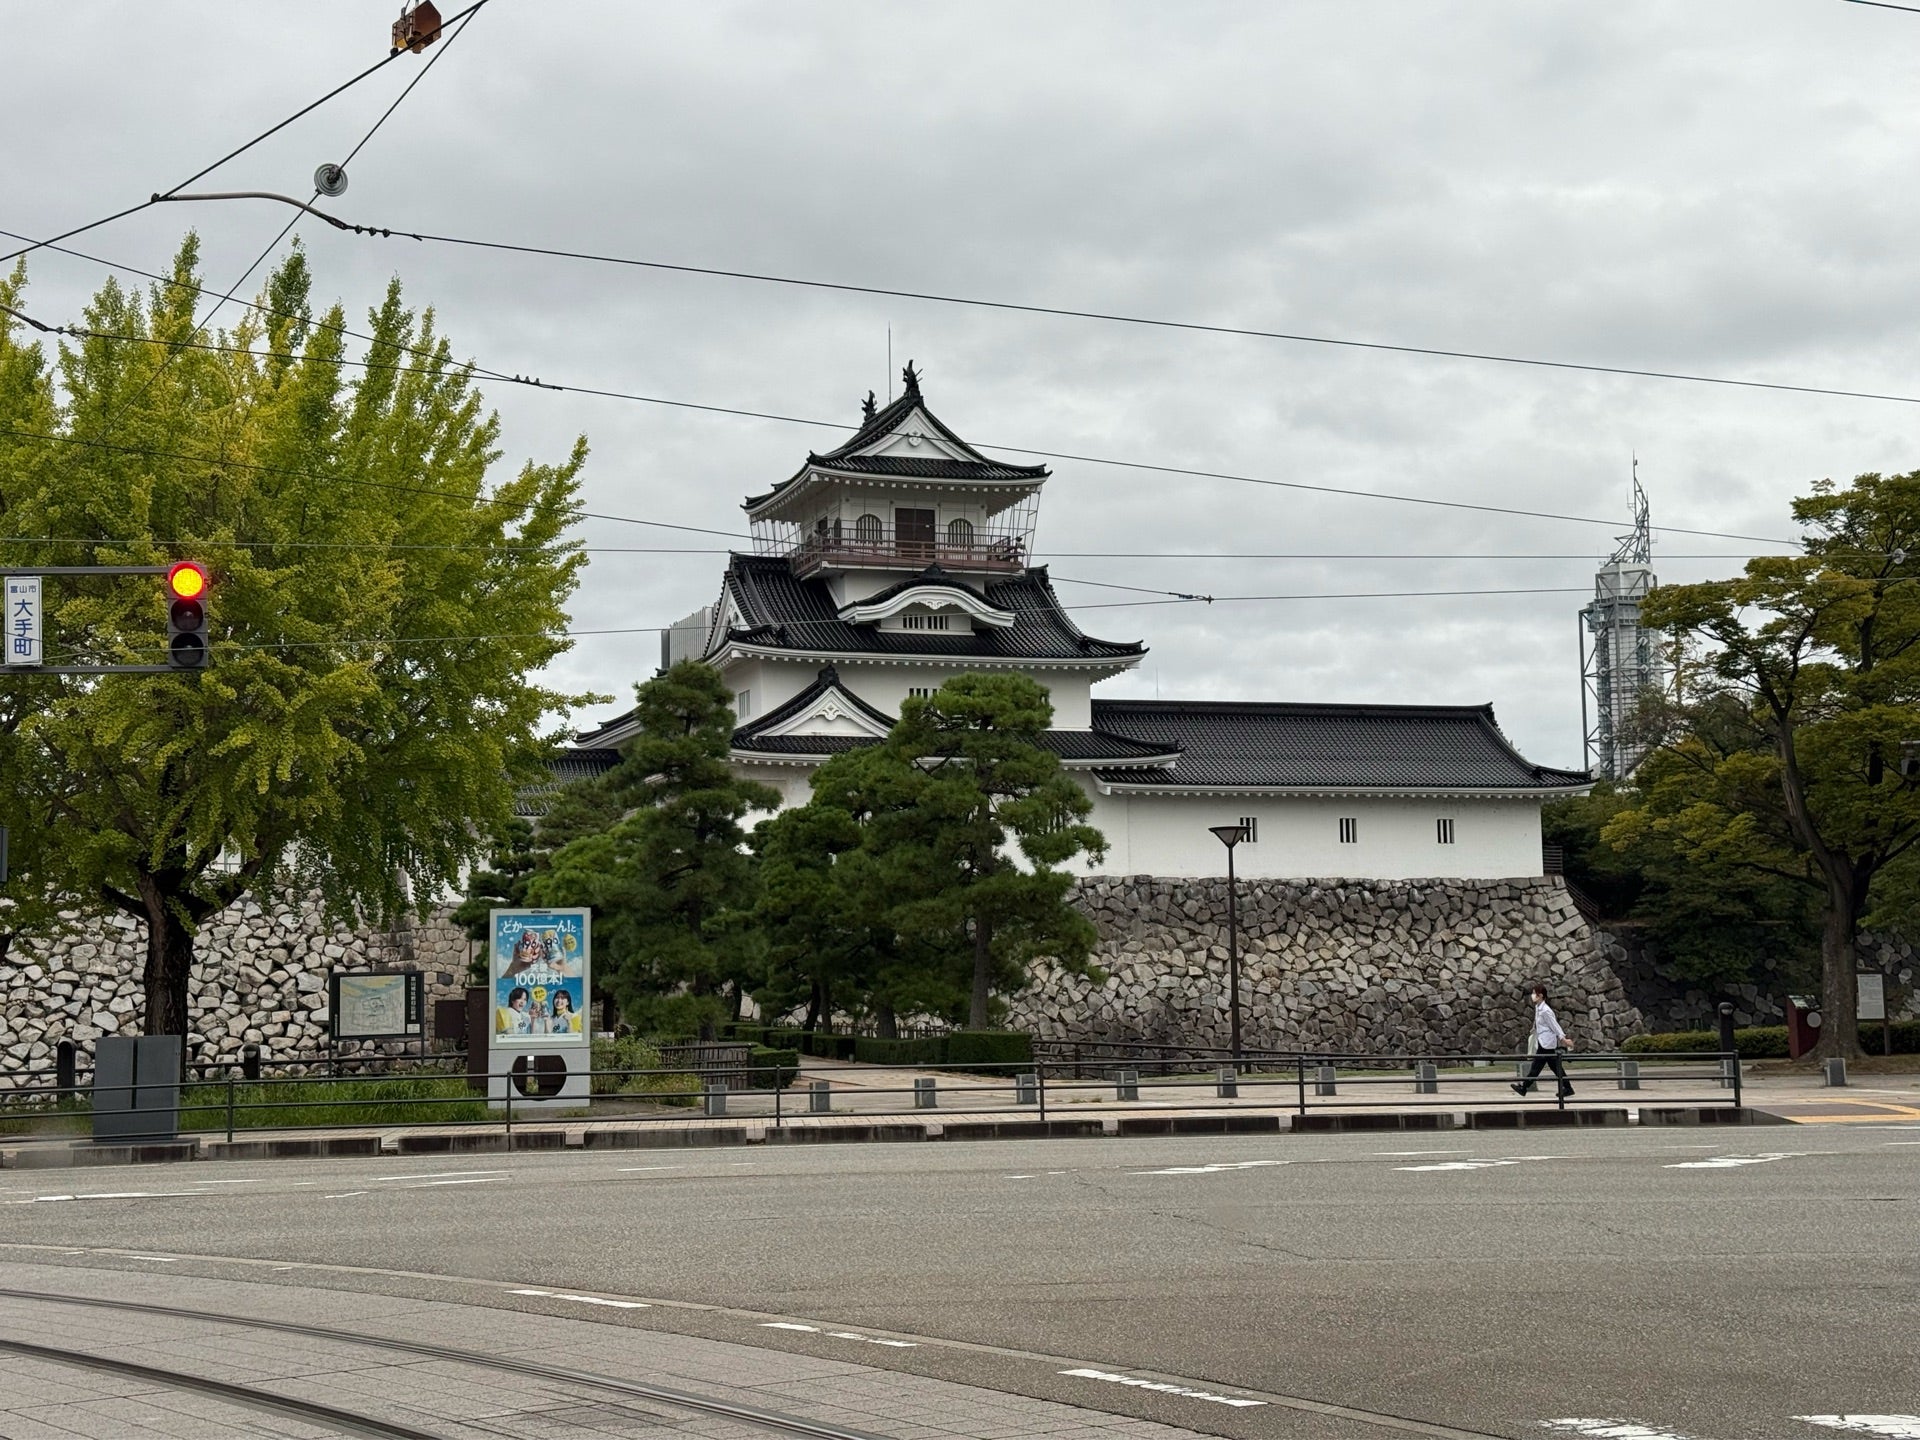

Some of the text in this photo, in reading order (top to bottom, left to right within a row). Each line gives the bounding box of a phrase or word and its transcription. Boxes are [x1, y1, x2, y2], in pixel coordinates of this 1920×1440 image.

[10, 585, 37, 593] 富山市
[14, 599, 33, 656] 大手町
